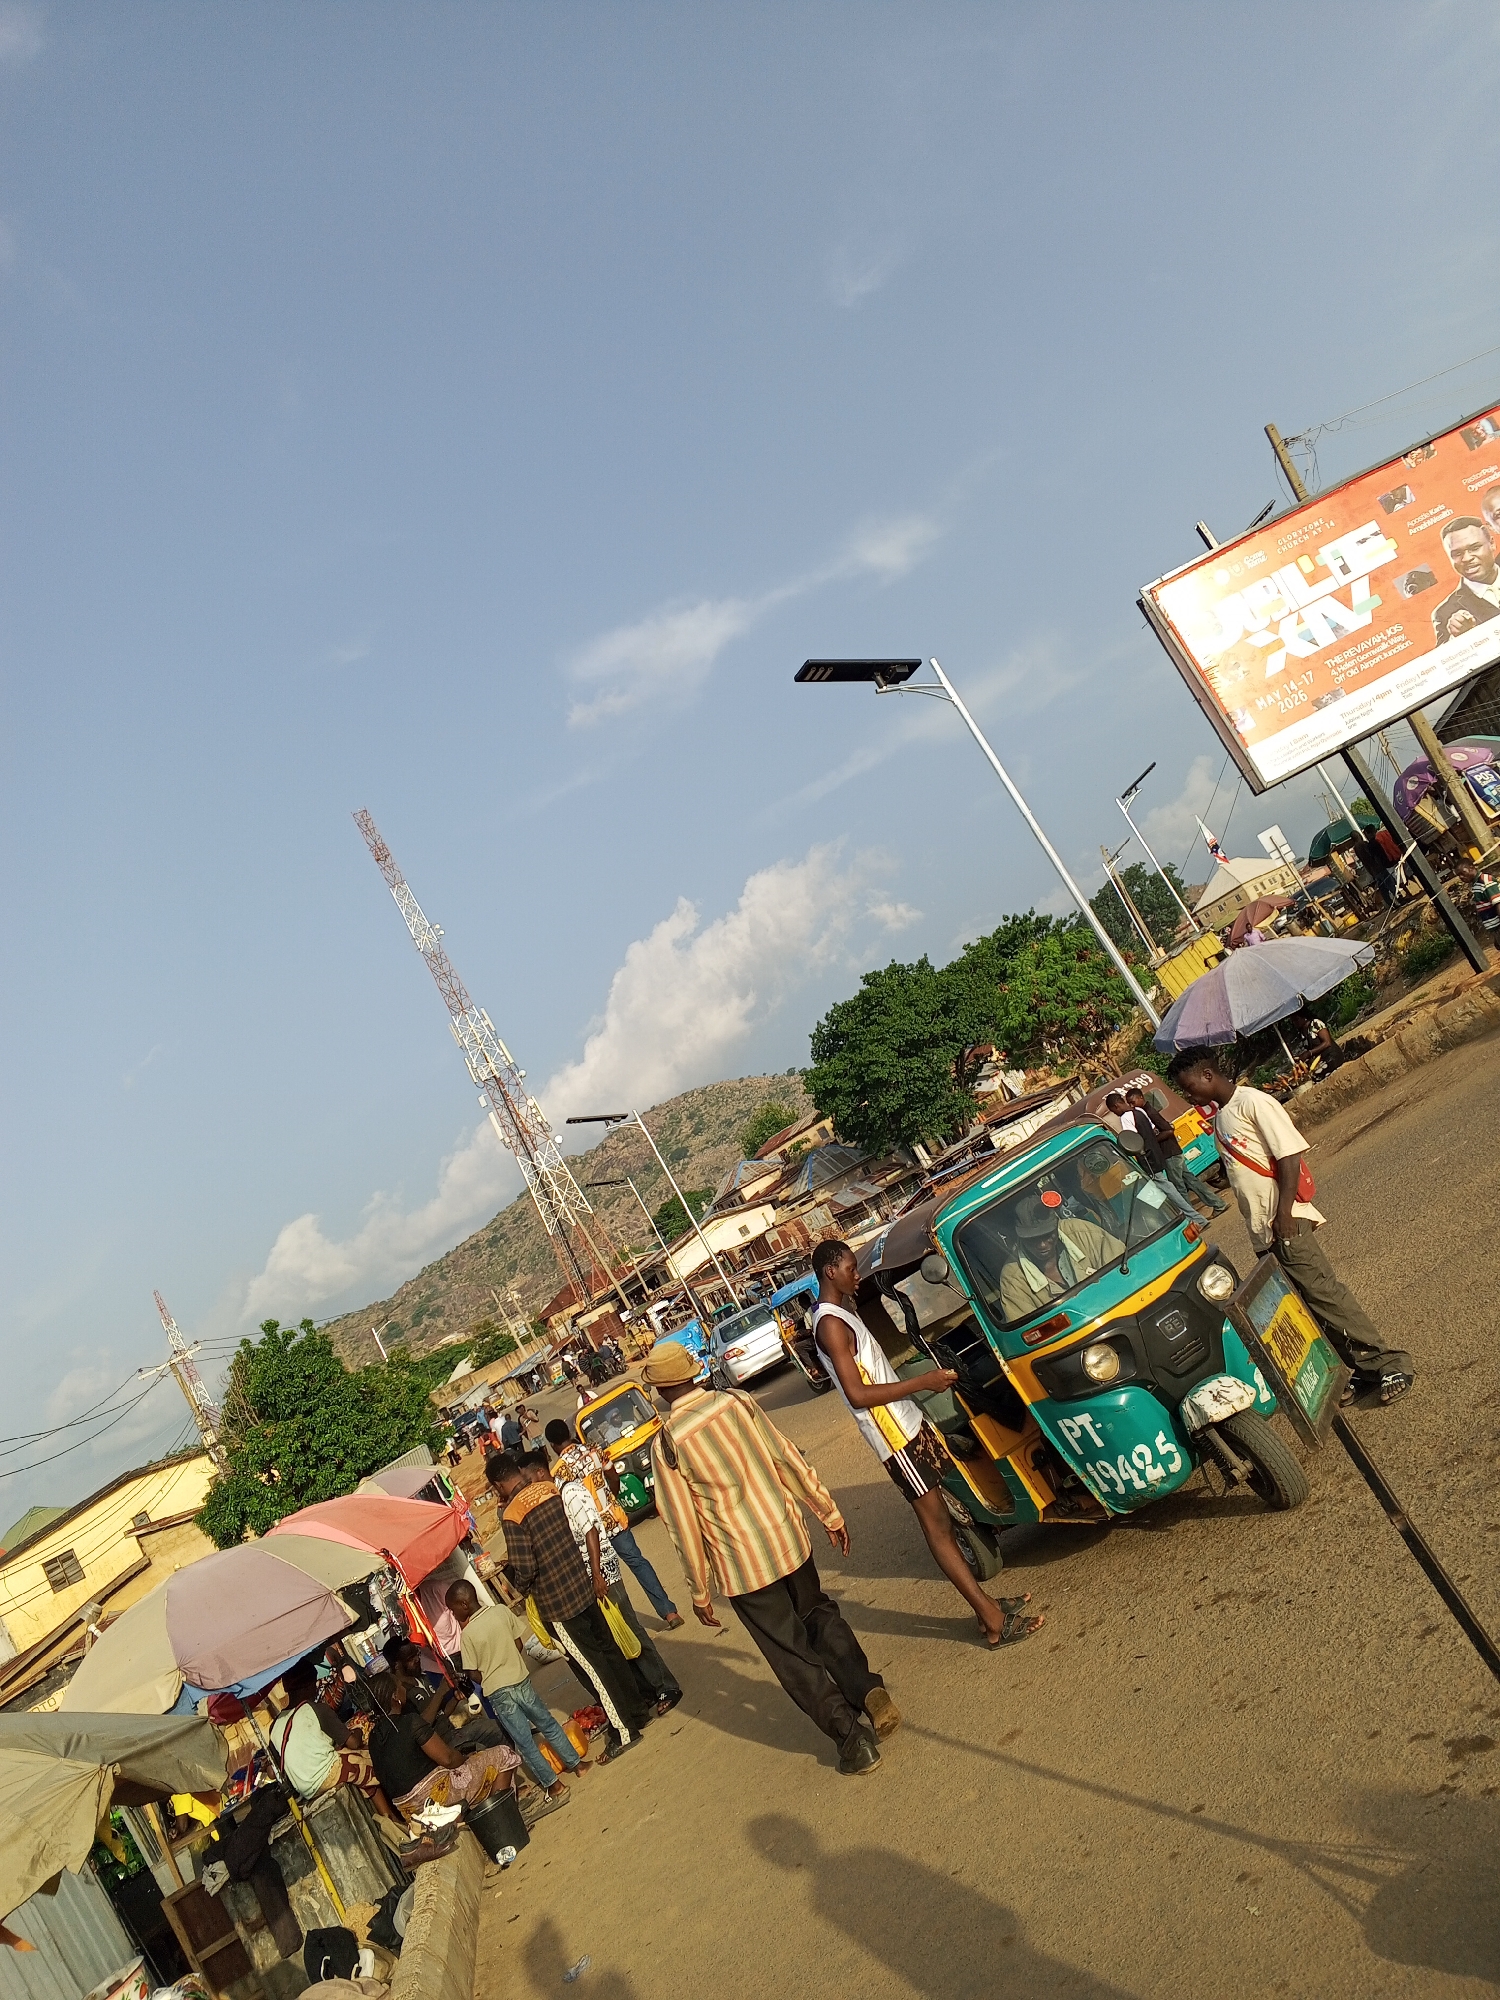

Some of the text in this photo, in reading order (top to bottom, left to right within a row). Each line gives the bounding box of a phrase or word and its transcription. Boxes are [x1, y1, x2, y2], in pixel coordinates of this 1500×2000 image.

[1407, 504, 1446, 527] Apostle Karis
[1276, 520, 1336, 554] CHURCH AT 14
[1277, 517, 1325, 546] GLORYZONE
[1243, 574, 1373, 679] XIV
[1386, 623, 1404, 637] JOS
[1338, 659, 1357, 672] Helen
[1356, 641, 1390, 661] Gomwalk
[1334, 673, 1346, 684] Off
[1346, 666, 1359, 678] Old
[1395, 674, 1417, 690] Friday
[1420, 665, 1437, 677] 4pm
[1255, 670, 1314, 711] MAY 14-17
[1277, 689, 1308, 714] 2026
[1339, 698, 1373, 720] Thursday
[1375, 688, 1393, 701] 4pm
[1473, 770, 1495, 782] POS
[1057, 1412, 1105, 1456] PT-
[1085, 1430, 1182, 1495] 19425
